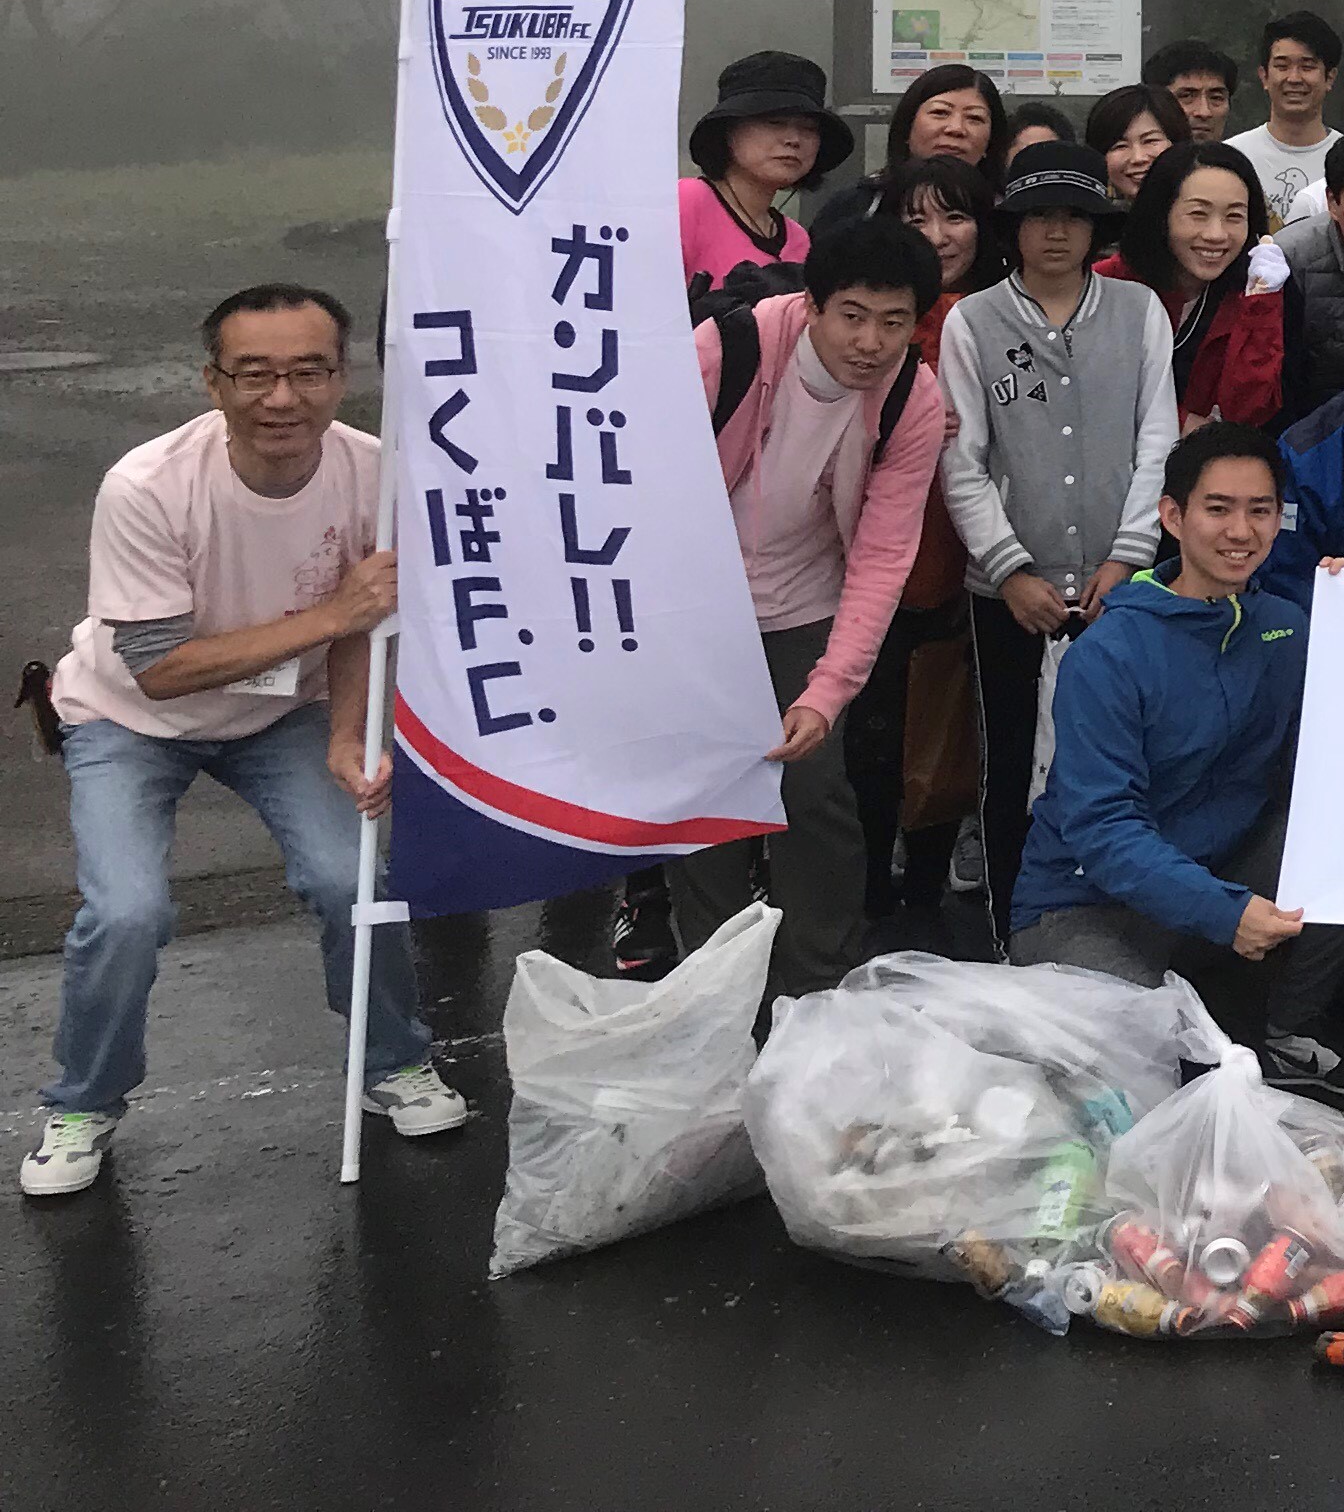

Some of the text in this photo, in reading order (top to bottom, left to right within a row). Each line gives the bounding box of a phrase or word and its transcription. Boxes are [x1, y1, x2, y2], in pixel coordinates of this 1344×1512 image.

[449, 5, 575, 40] TSUKUBA
[487, 47, 552, 60] SINCE 1993
[990, 373, 1018, 406] 07
